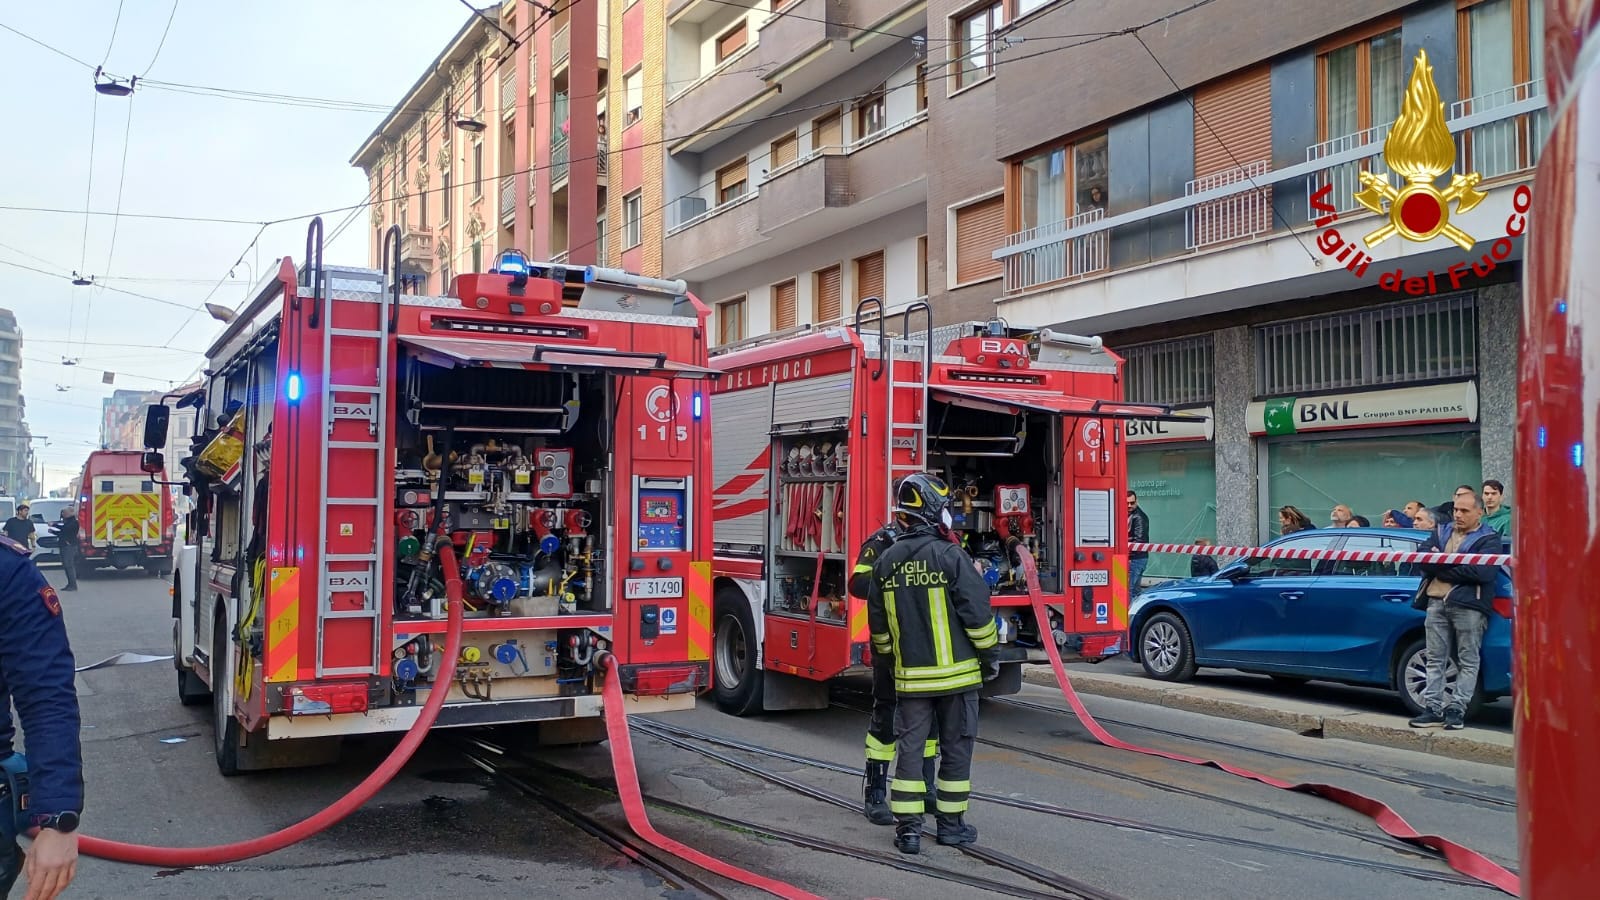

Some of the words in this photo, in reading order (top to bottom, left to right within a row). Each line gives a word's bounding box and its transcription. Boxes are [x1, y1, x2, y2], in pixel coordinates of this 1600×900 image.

[981, 340, 1028, 358] BAI
[727, 370, 753, 390] DEL
[761, 359, 812, 384] FUOCO
[333, 406, 372, 416] BAI
[1300, 401, 1359, 423] BNL
[1363, 411, 1395, 419] Gruppo
[1398, 408, 1418, 416] BNP
[1420, 404, 1464, 415] PARIBAS
[1126, 419, 1169, 436] BNL
[329, 577, 368, 586] BAI
[628, 582, 641, 595] VF
[647, 581, 681, 594] 31490
